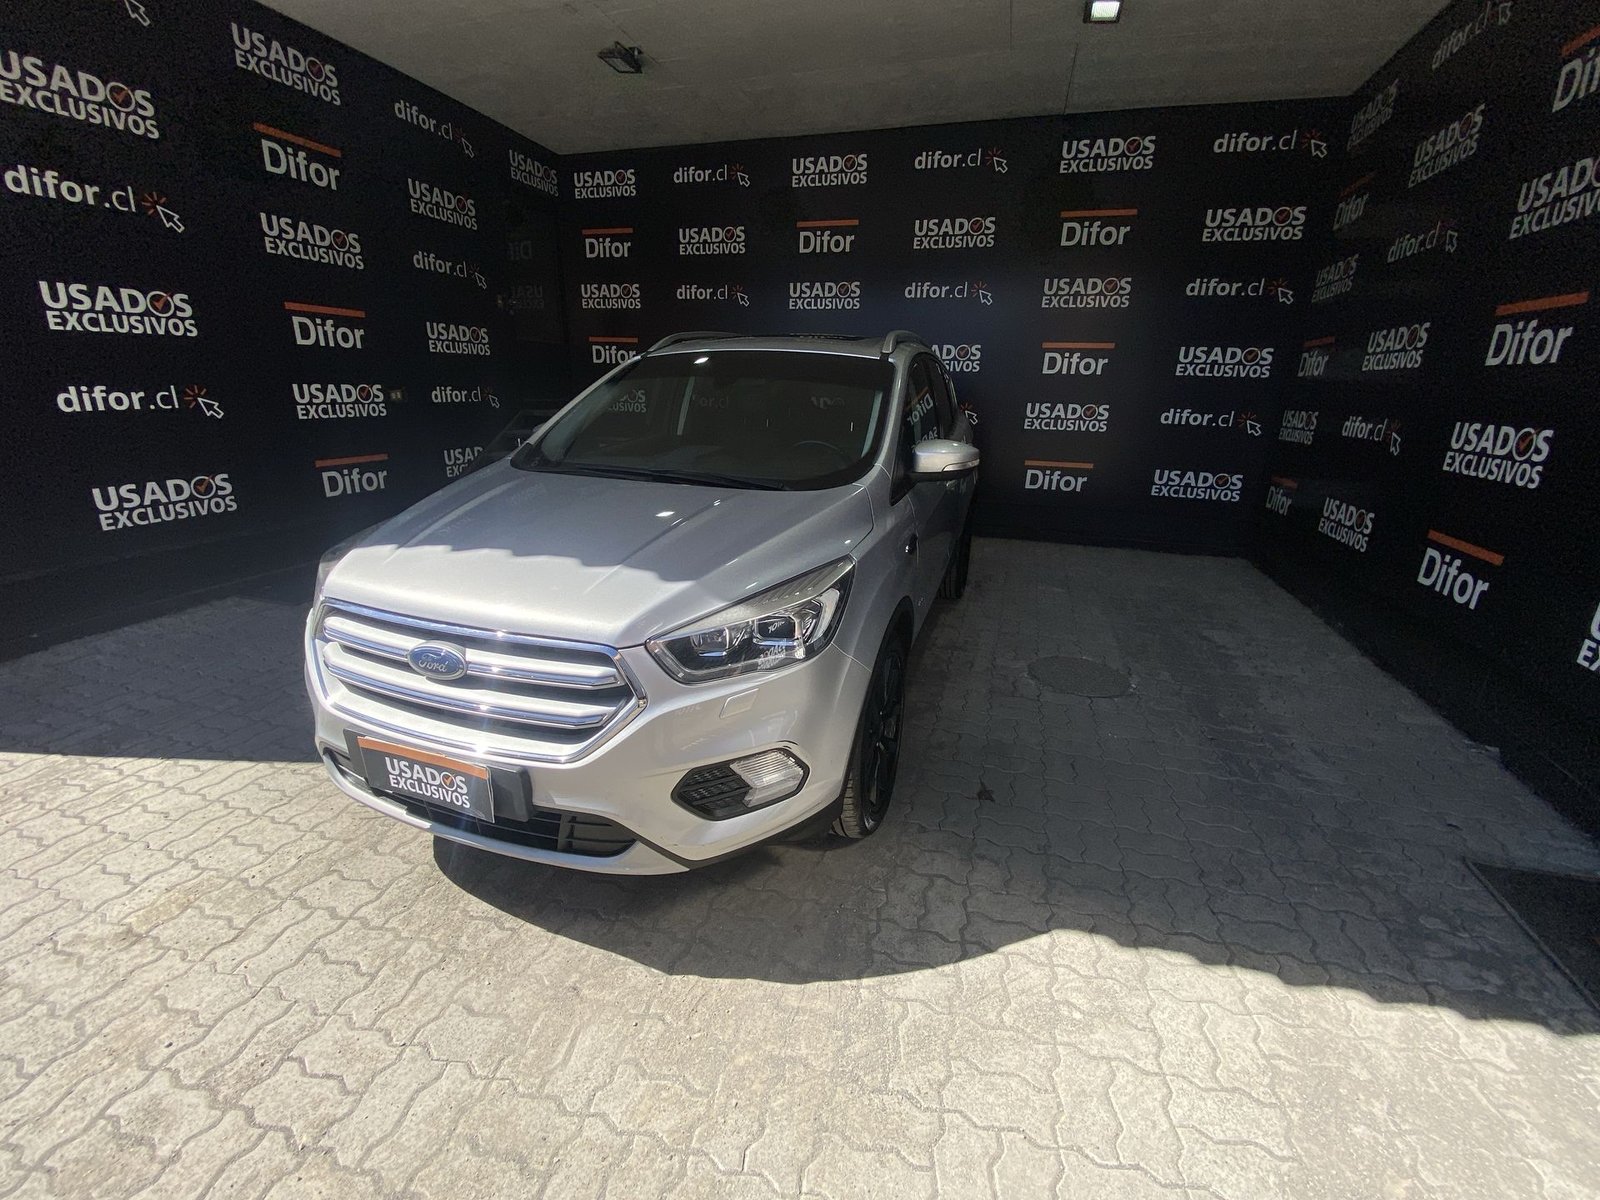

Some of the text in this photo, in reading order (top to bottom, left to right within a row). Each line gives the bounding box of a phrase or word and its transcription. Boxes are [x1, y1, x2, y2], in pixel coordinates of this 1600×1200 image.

[230, 22, 338, 87] USADOS
[0, 50, 155, 117] USADOS
[235, 49, 341, 106] EXCLUSIVOS
[0, 79, 160, 139] EXCLUSIVOS
[394, 100, 452, 141] difor.cl
[1061, 135, 1156, 159] USADOS
[1213, 129, 1297, 153] difor.cl
[1413, 103, 1486, 167] USADOS
[261, 139, 340, 190] Difor
[509, 149, 558, 185] USADOS
[792, 153, 868, 174] USADOS
[914, 148, 982, 170] difor.cl
[1059, 156, 1153, 174] EXCLUSIVOS
[1408, 134, 1480, 189] EXCLUSIVOS
[510, 166, 559, 197] EXCLUSIVOS
[573, 168, 636, 188] USADOS
[673, 164, 728, 184] difor.cl
[791, 171, 868, 188] EXCLUSIVOS
[1517, 157, 1600, 213] USAD
[4, 165, 136, 213] difor.cl
[408, 178, 476, 217] USADOS
[574, 185, 637, 199] EXCLUSIVOS
[410, 198, 478, 231] EXCLUSIVOS
[914, 216, 996, 237] USADOS
[1204, 206, 1307, 228] USADOS
[260, 212, 361, 253] USADOS
[679, 225, 745, 244] USADOS
[799, 230, 855, 254] Difor
[913, 234, 995, 249] EXCLUSIVOS
[1060, 221, 1131, 247] Difor
[1201, 226, 1304, 242] EXCLUSIVOS
[1387, 221, 1441, 263] difor.cl
[264, 236, 365, 270] EXCLUSIVOS
[585, 238, 631, 259] Difor
[679, 242, 746, 255] EXCLUSIVOS
[413, 250, 467, 278] difor.cl
[581, 283, 640, 299] USADOS
[676, 284, 728, 300] difor.cl
[789, 281, 860, 298] USADOS
[904, 281, 968, 299] difor.cl
[1043, 277, 1132, 295] USADOS
[1185, 278, 1265, 296] difor.cl
[38, 280, 193, 318] USADOS
[582, 298, 641, 309] EXCLUSIVOS
[788, 298, 860, 310] EXCLUSIVOS
[1041, 295, 1130, 308] EXCLUSIVOS
[46, 310, 198, 337] EXCLUSIVOS
[292, 316, 365, 349] Difor
[426, 321, 488, 344] USADOS
[429, 340, 491, 356] EXCLUSIVOS
[1368, 322, 1431, 354] USADOS
[1484, 320, 1573, 366] Difor
[931, 344, 982, 360] ADOS
[1041, 351, 1109, 376] Difor
[1178, 346, 1274, 366] USADOS
[1297, 351, 1329, 377] Difor
[1361, 350, 1424, 371] EXCLUSIVOS
[943, 360, 981, 373] SIVOS
[1175, 363, 1271, 379] EXCLUSIVOS
[56, 385, 179, 413] difor.cl
[292, 383, 384, 404] USADOS
[431, 386, 481, 403] difor.cl
[296, 402, 387, 420] EXCLUSIVOS
[1025, 402, 1109, 421] USADOS
[1160, 408, 1235, 427] difor.cl
[1282, 410, 1319, 430] USADOS
[1023, 418, 1108, 432] EXCLUSIVOS
[1278, 428, 1315, 446] EXCLUSIVOS
[1341, 416, 1388, 441] difor.cl
[1450, 422, 1554, 462] USADOS
[443, 446, 483, 465] USA
[1024, 468, 1088, 493] Difor
[1154, 468, 1244, 490] USADOS
[1442, 451, 1544, 489] EXCLUSIVOS
[91, 473, 233, 511] USADOS
[322, 467, 388, 498] Difor
[1150, 484, 1241, 502] EXCLUSIVOS
[99, 495, 238, 531] EXCLUSIVOS
[1265, 485, 1292, 517] Difor
[1322, 497, 1375, 535] USADOS
[1318, 517, 1369, 553] EXCLUSIVOS
[1417, 547, 1490, 611] Difor
[418, 652, 450, 672] Ford
[385, 756, 468, 794] USADOS
[389, 774, 471, 809] EXCLUSIVOS
